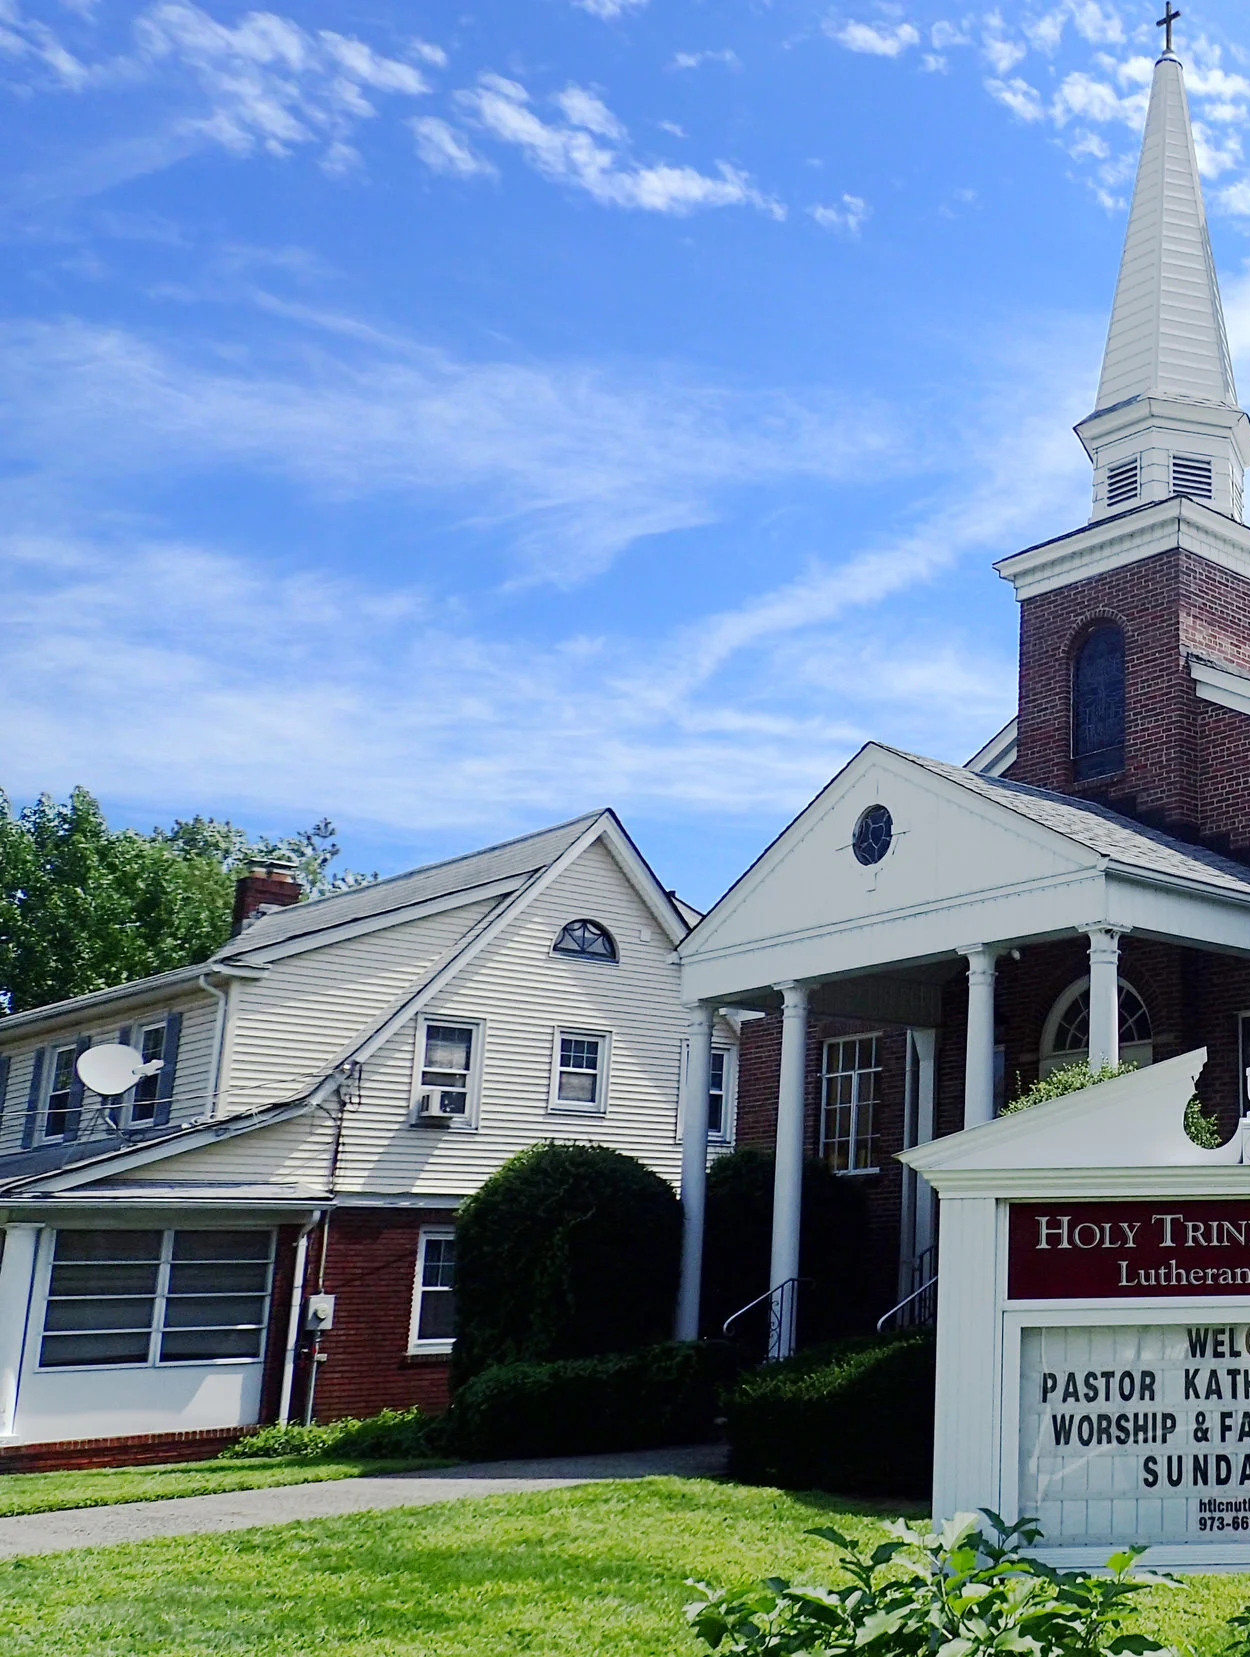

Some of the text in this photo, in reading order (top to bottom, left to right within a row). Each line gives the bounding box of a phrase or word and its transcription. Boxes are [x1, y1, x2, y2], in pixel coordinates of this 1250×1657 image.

[1035, 1215, 1139, 1249] HOLY
[1042, 1370, 1156, 1403] PASTOR
[1052, 1412, 1176, 1446] WORSHIP
[1193, 1411, 1211, 1442] &
